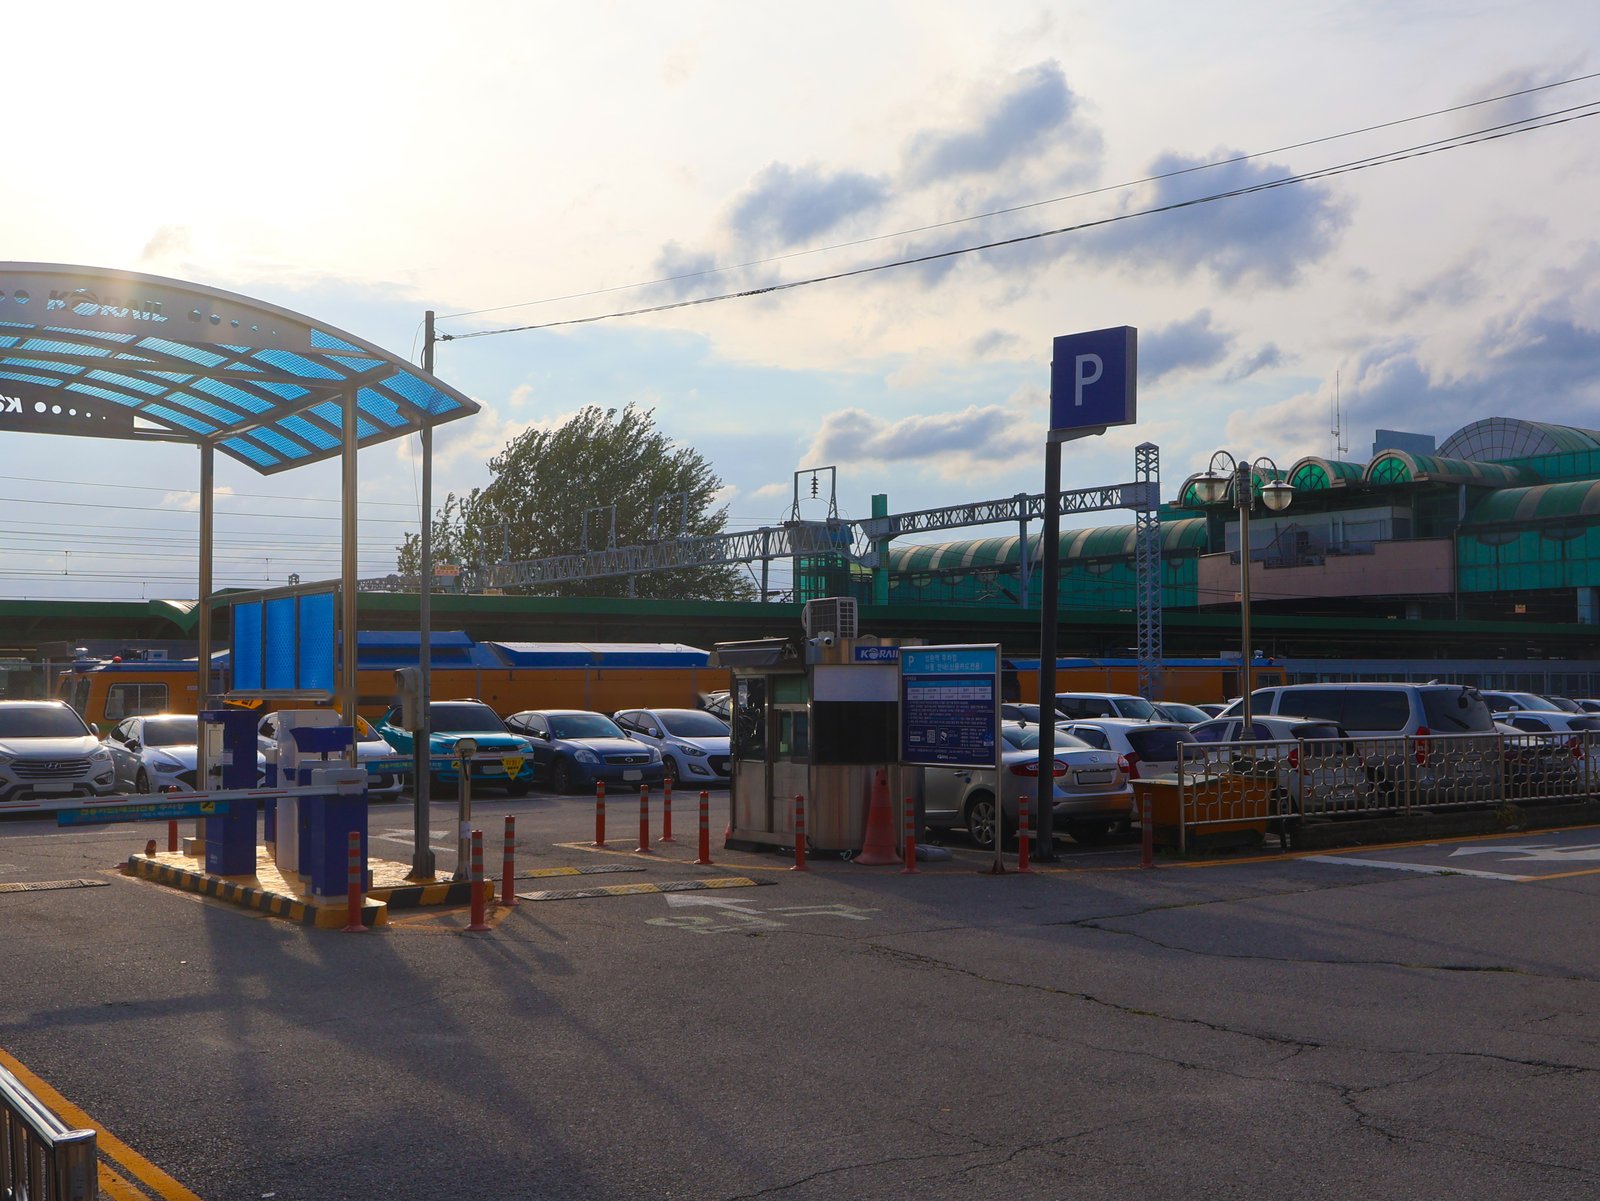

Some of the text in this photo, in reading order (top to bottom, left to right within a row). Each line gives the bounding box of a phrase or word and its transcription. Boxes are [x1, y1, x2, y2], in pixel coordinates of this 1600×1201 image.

[47, 288, 168, 323] KORAIL
[1075, 353, 1103, 407] P
[908, 655, 915, 667] P
